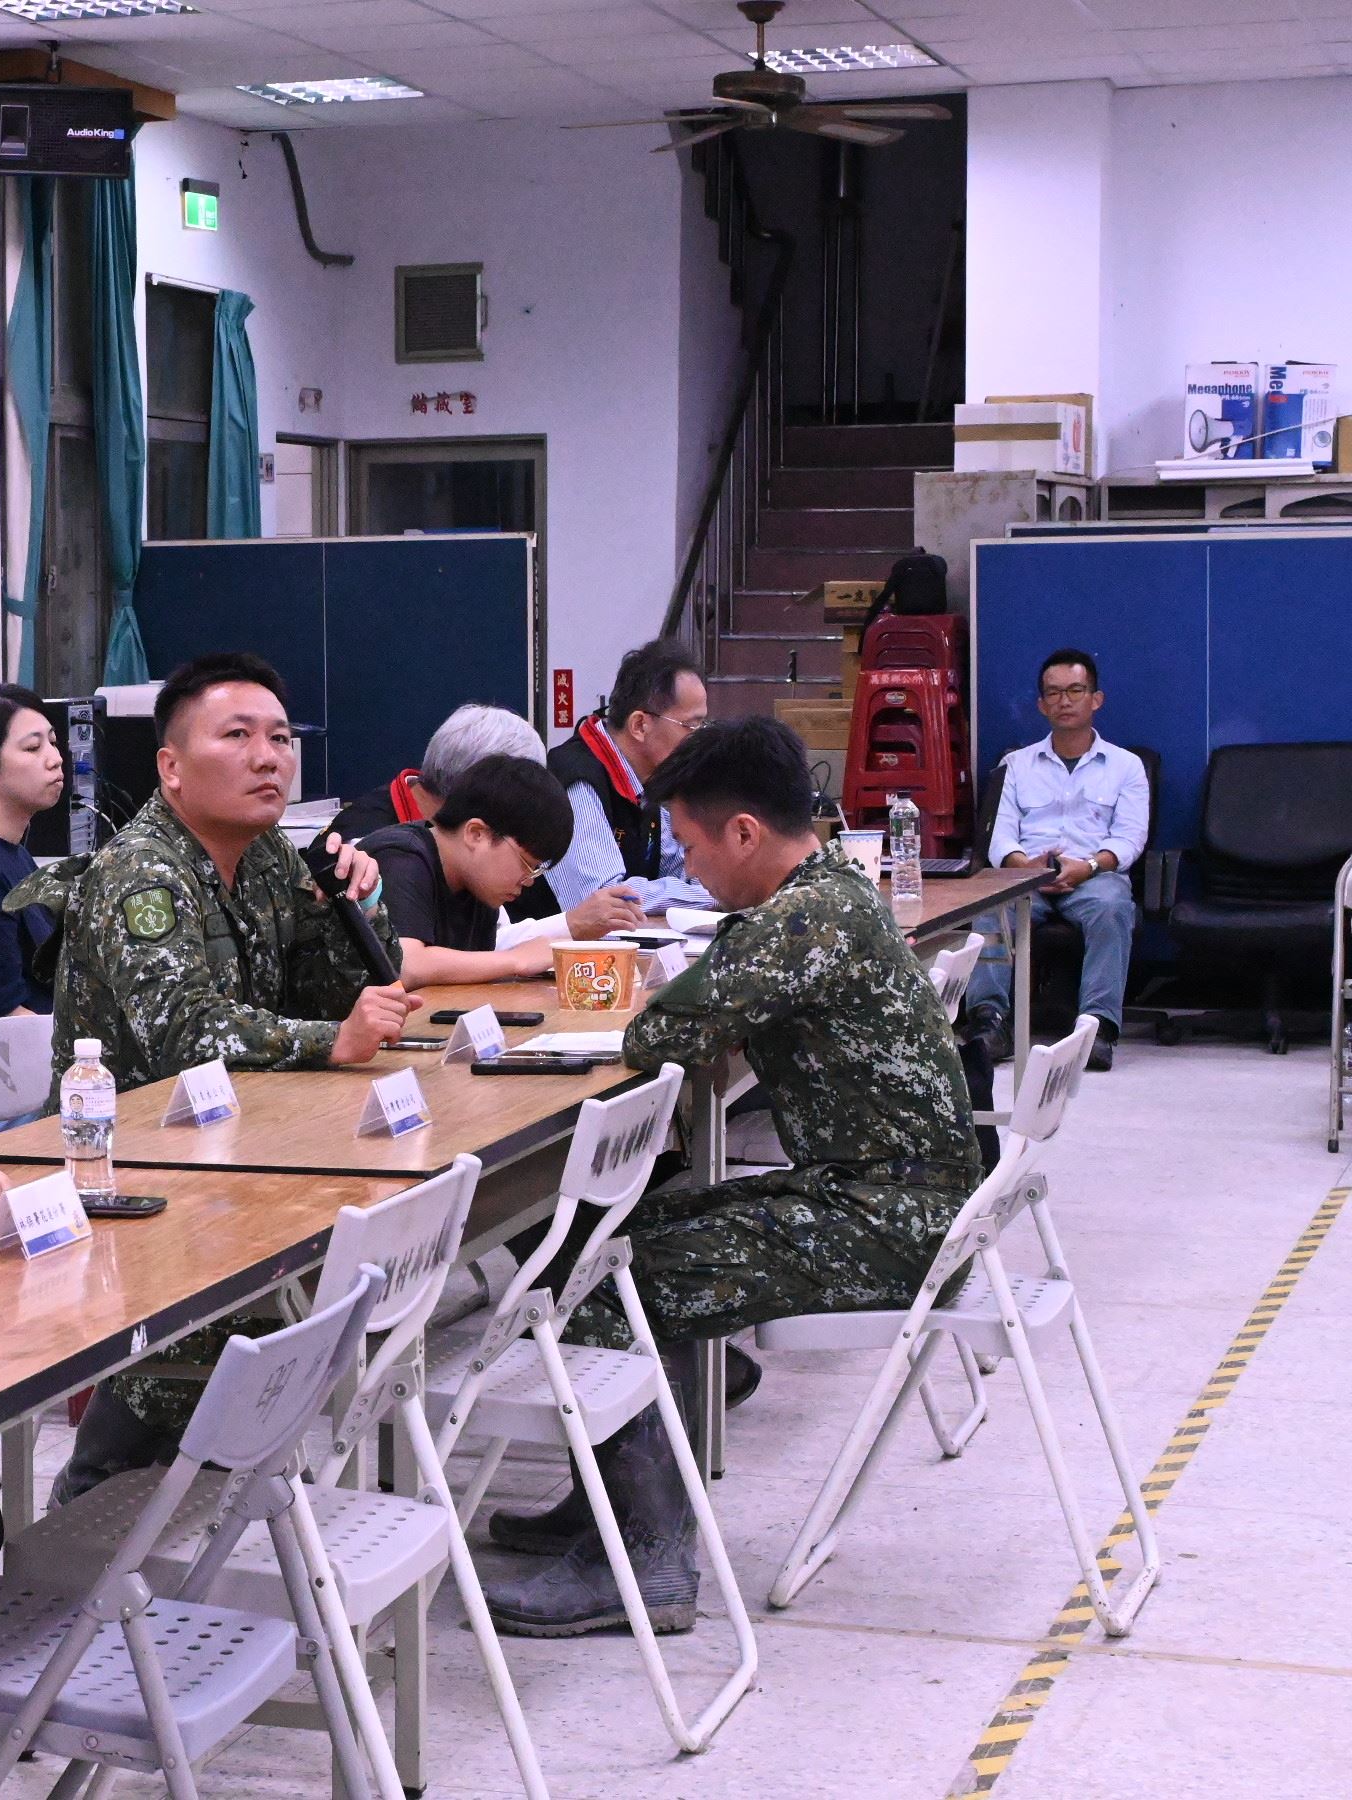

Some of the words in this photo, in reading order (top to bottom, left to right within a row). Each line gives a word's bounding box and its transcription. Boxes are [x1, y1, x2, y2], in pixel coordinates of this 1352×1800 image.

[67, 128, 115, 139] AudioKing
[1187, 383, 1253, 398] Megaphone
[557, 673, 570, 724] 滅火器
